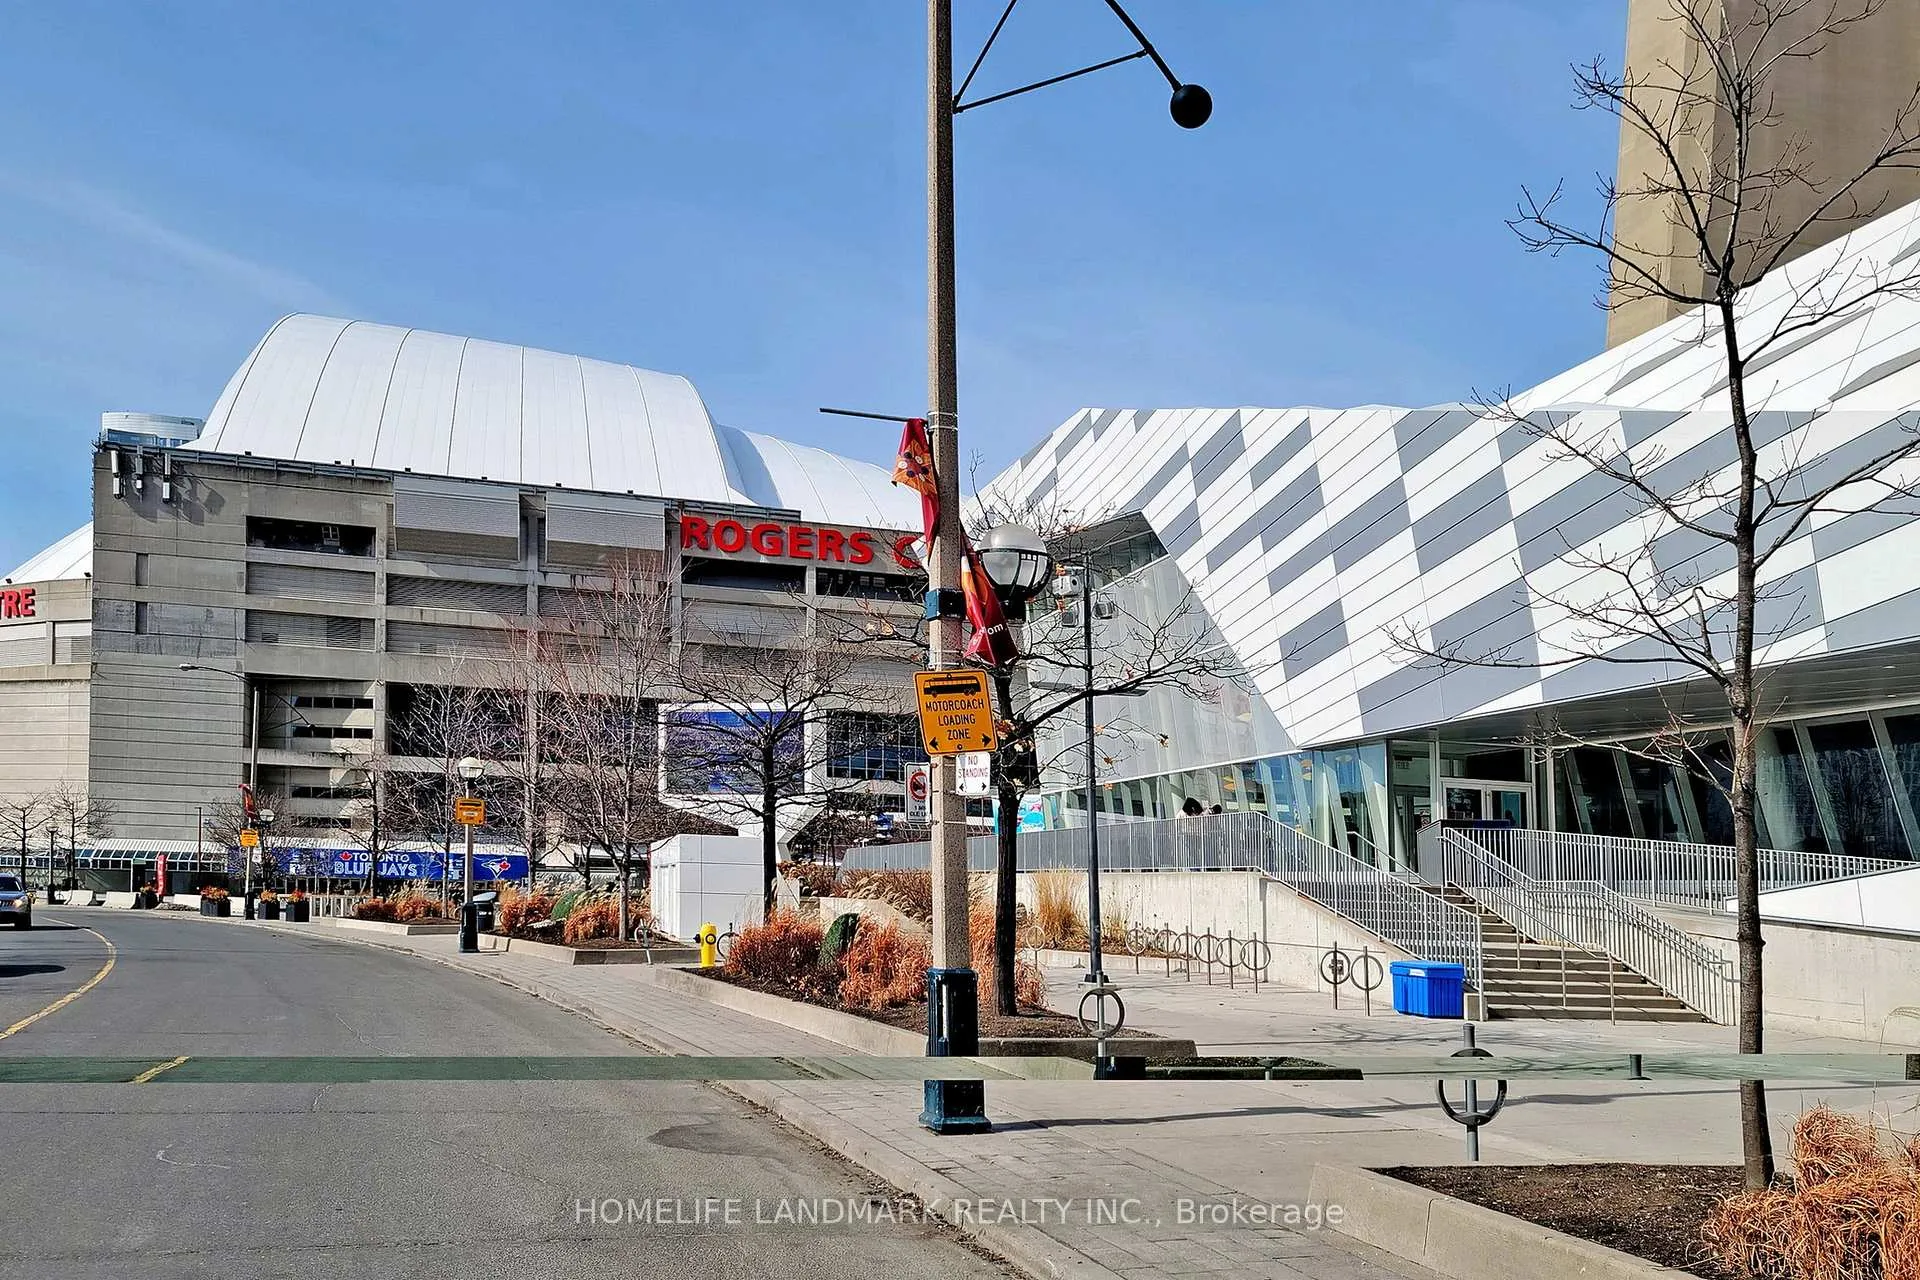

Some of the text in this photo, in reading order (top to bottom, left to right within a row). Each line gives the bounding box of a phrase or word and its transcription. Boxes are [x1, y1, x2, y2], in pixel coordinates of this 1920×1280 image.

[681, 515, 873, 565] ROGERS
[926, 699, 984, 712] MOTORCOACH
[938, 714, 976, 726] LOADING
[947, 729, 971, 740] ZONE
[968, 755, 978, 765] NO
[958, 767, 988, 778] STANDING
[378, 862, 417, 876] JAYS
